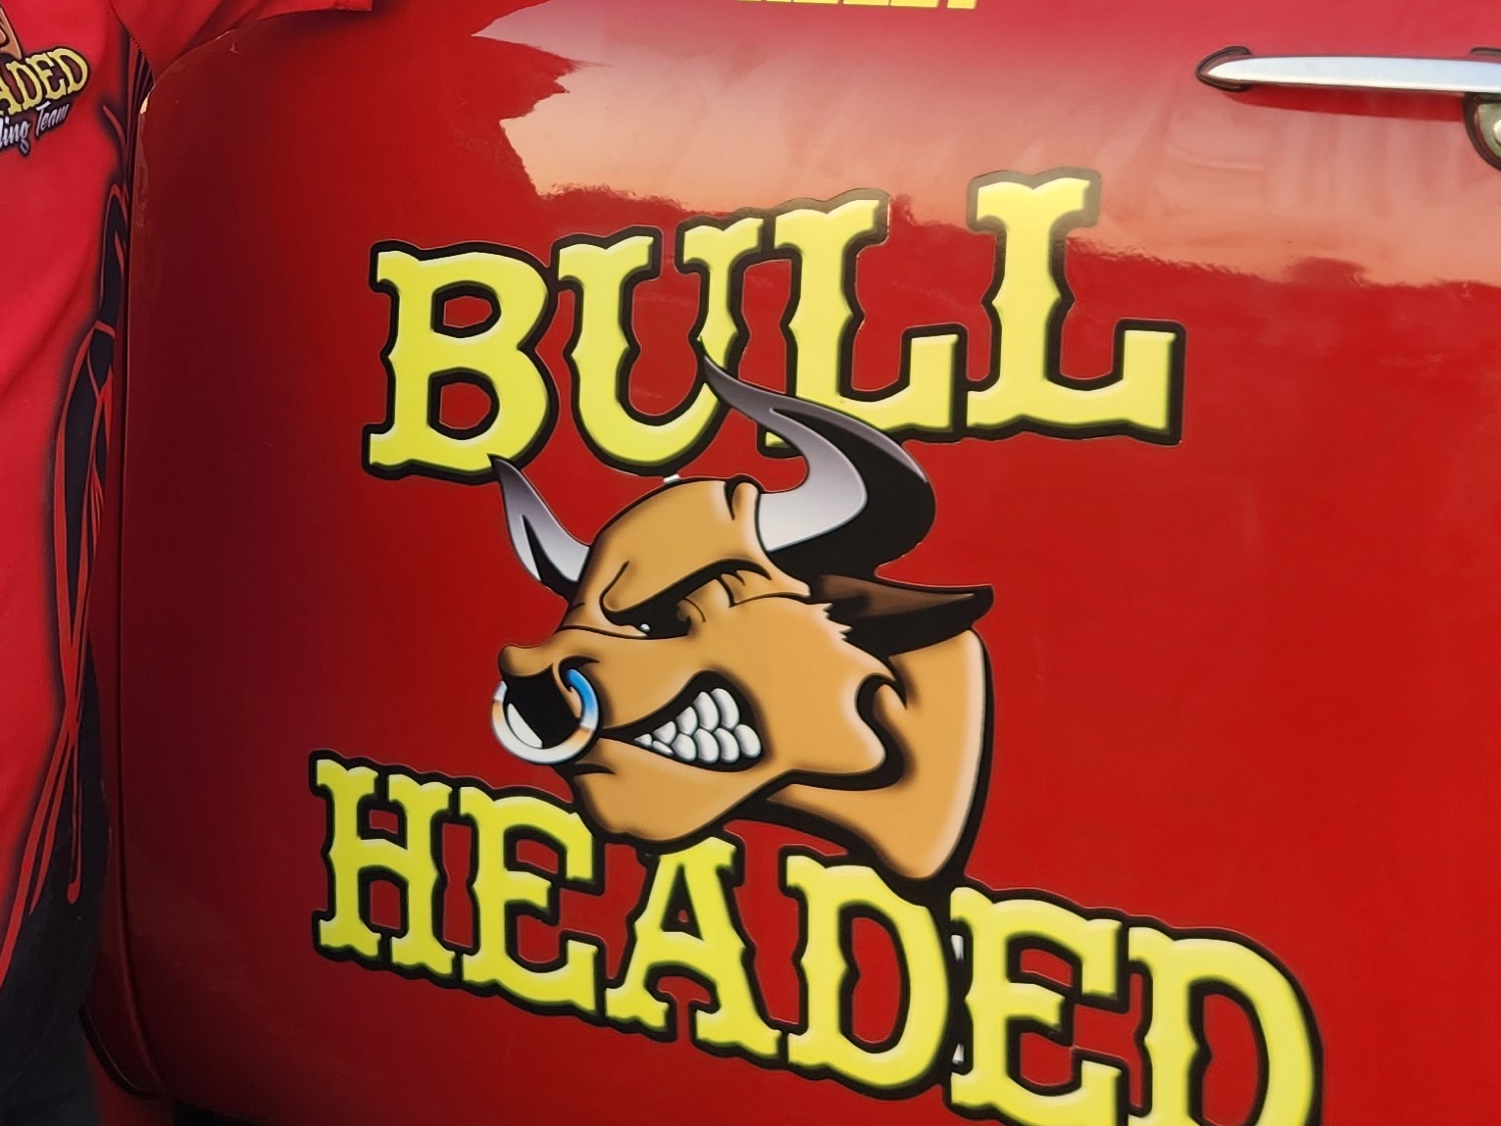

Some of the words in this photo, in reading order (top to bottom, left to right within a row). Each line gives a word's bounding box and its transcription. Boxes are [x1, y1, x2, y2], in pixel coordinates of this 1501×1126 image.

[34, 100, 71, 138] Team
[366, 175, 1187, 477] BULL
[313, 758, 1319, 1126] HEADED
